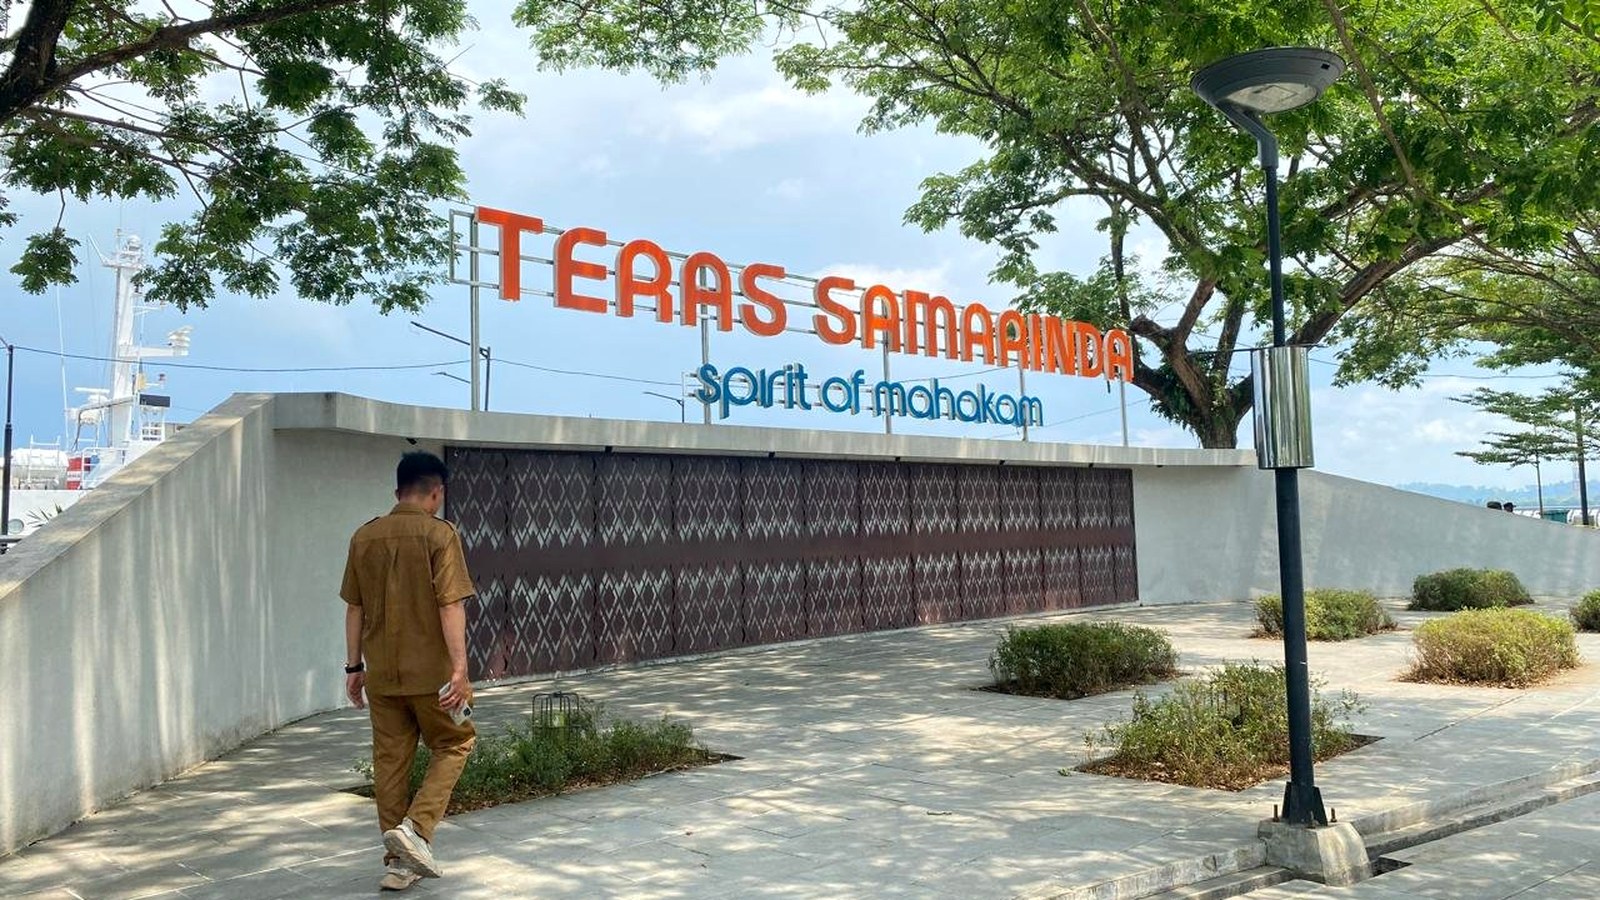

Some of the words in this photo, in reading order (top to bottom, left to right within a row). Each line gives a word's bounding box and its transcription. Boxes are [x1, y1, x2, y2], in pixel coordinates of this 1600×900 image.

[474, 206, 787, 337] TERAS
[812, 276, 1134, 383] SAMARINDA
[696, 363, 812, 420] spirit
[819, 369, 865, 416] of
[871, 378, 1043, 427] mahakam
